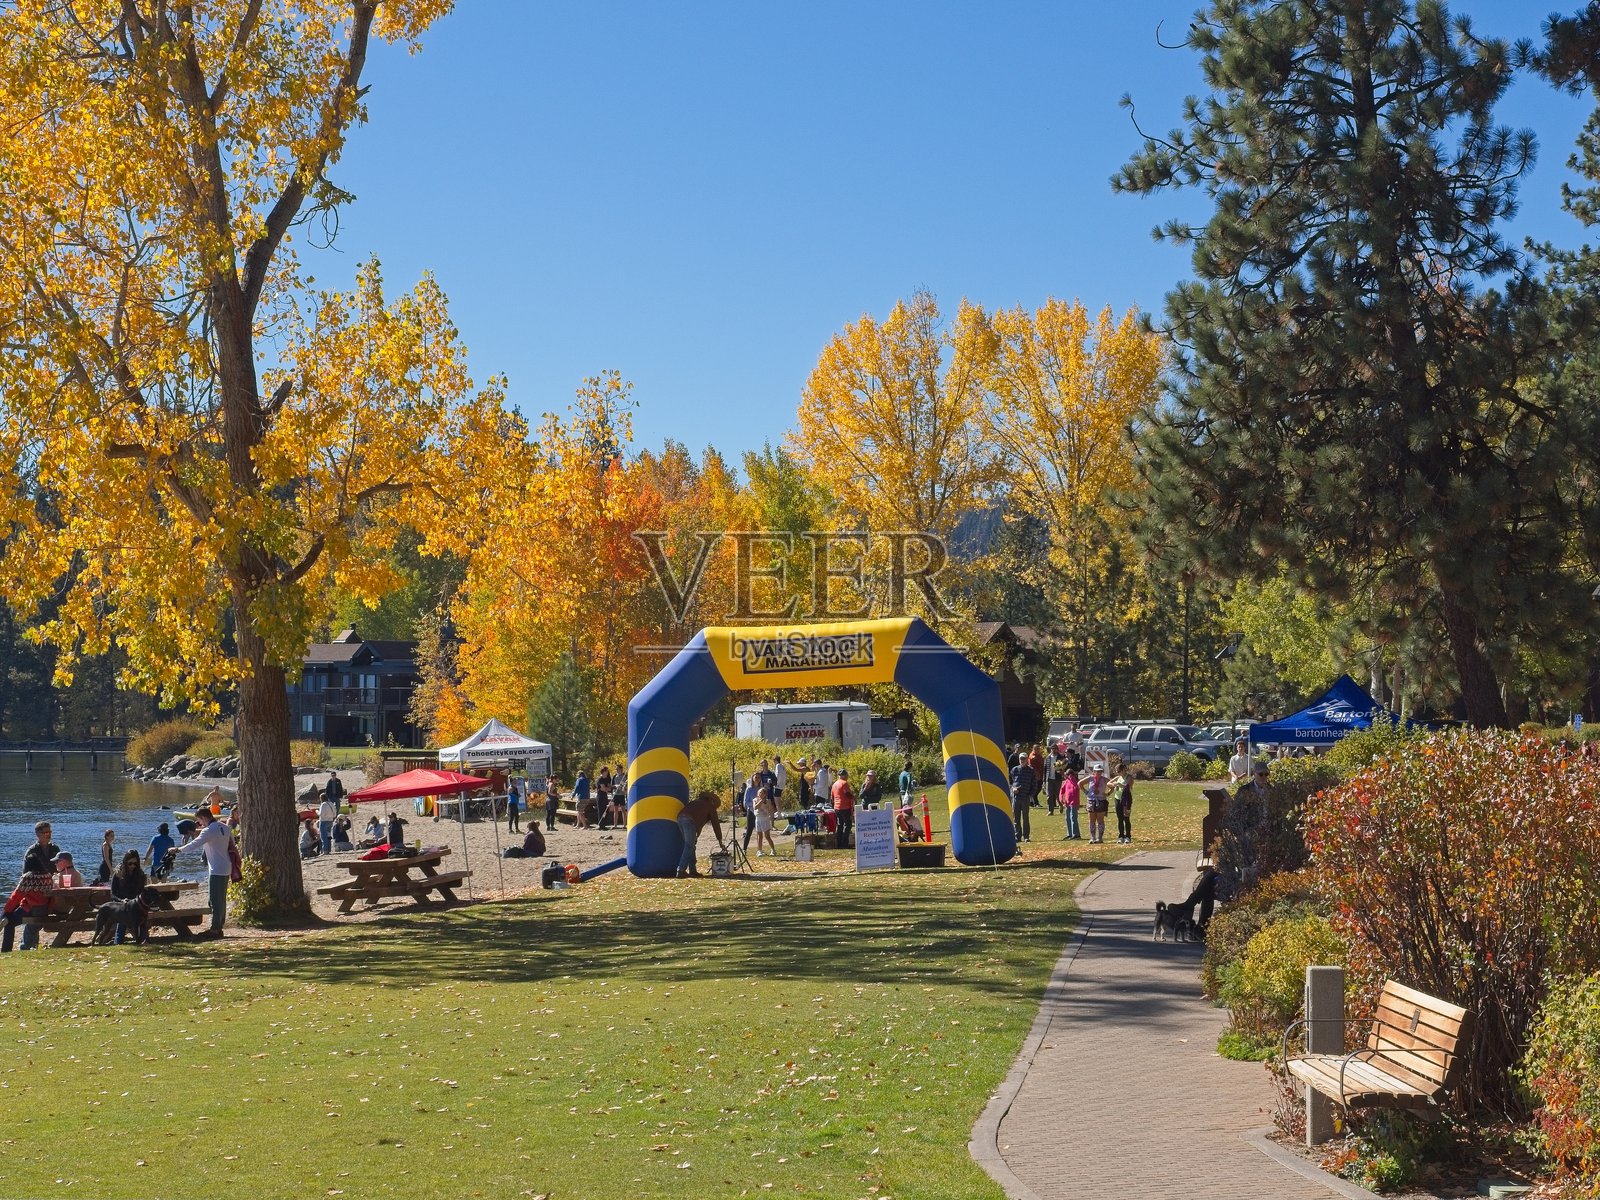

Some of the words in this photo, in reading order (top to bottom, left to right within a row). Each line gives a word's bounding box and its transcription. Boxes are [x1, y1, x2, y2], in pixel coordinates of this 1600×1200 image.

[765, 653, 851, 669] MARATHON
[1325, 710, 1373, 719] Barton
[785, 729, 825, 739] KAYAK
[467, 749, 544, 758] TahoeCityKayak.com
